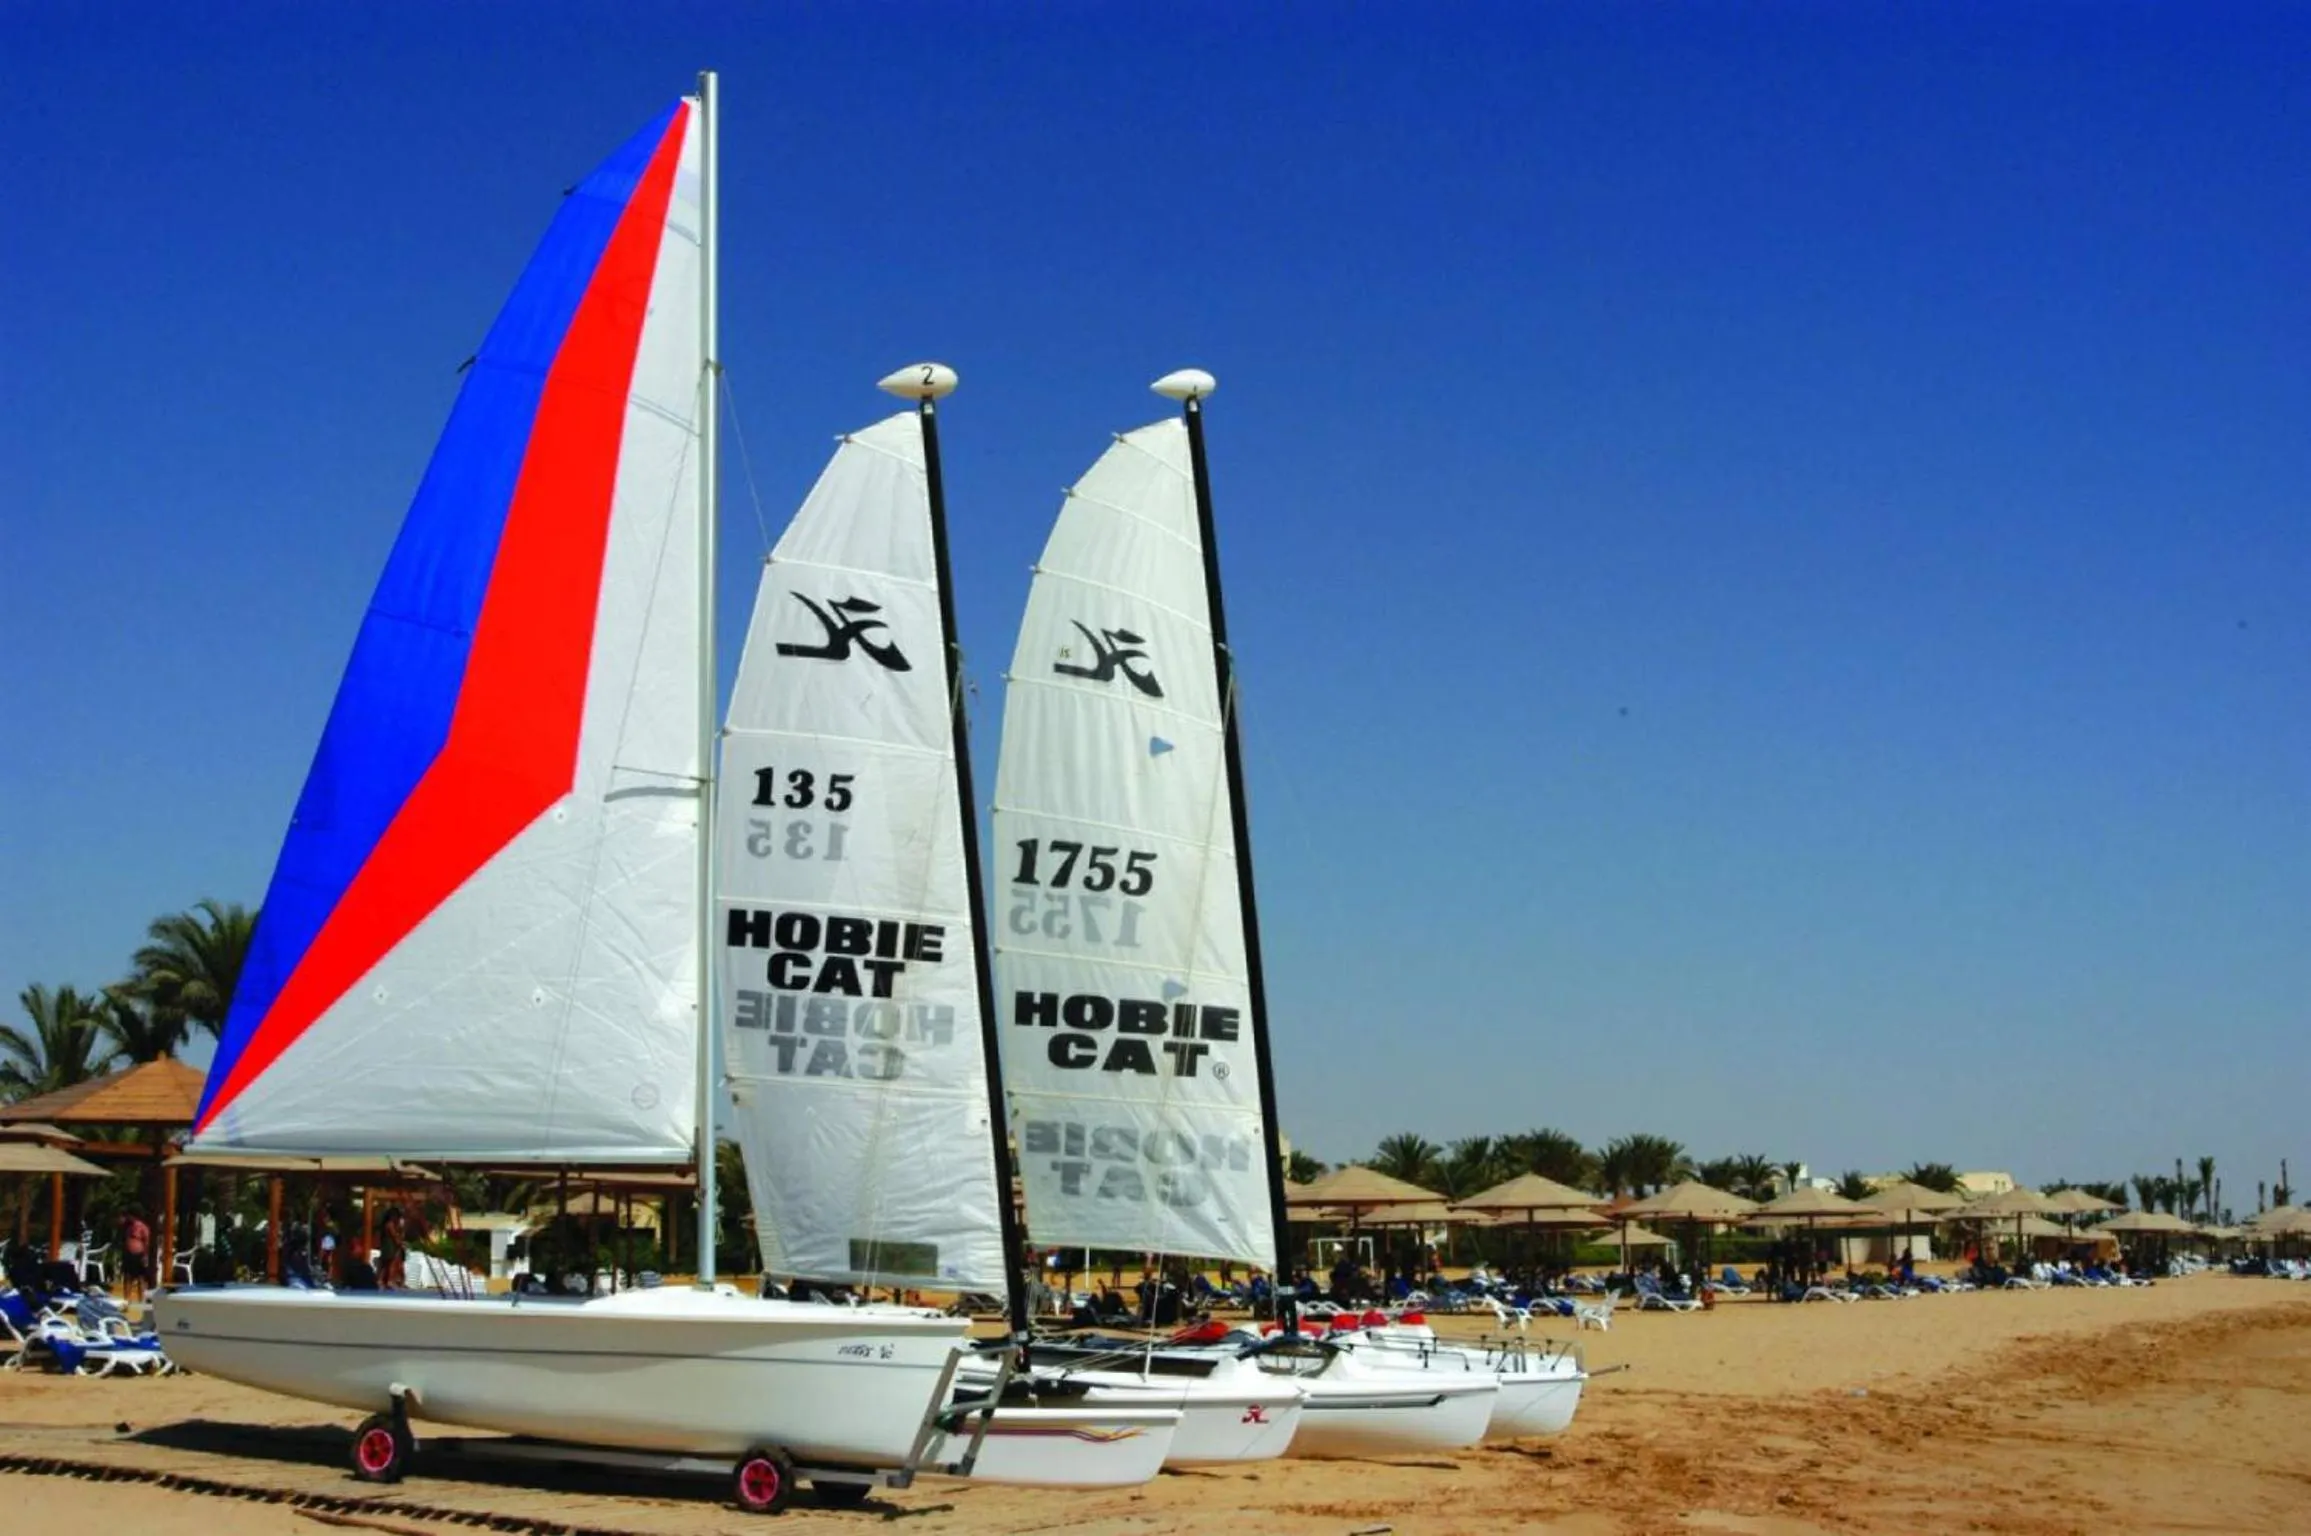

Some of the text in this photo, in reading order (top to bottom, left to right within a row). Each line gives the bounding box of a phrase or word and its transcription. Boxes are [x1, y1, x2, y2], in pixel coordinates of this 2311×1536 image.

[921, 365, 935, 386] 2
[751, 767, 855, 812] 135
[1012, 837, 1158, 897] 1755
[727, 908, 946, 963] HOBIE
[766, 952, 906, 999] CAT
[1014, 990, 1241, 1043] HOBIE
[1047, 1033, 1209, 1078] CAT
